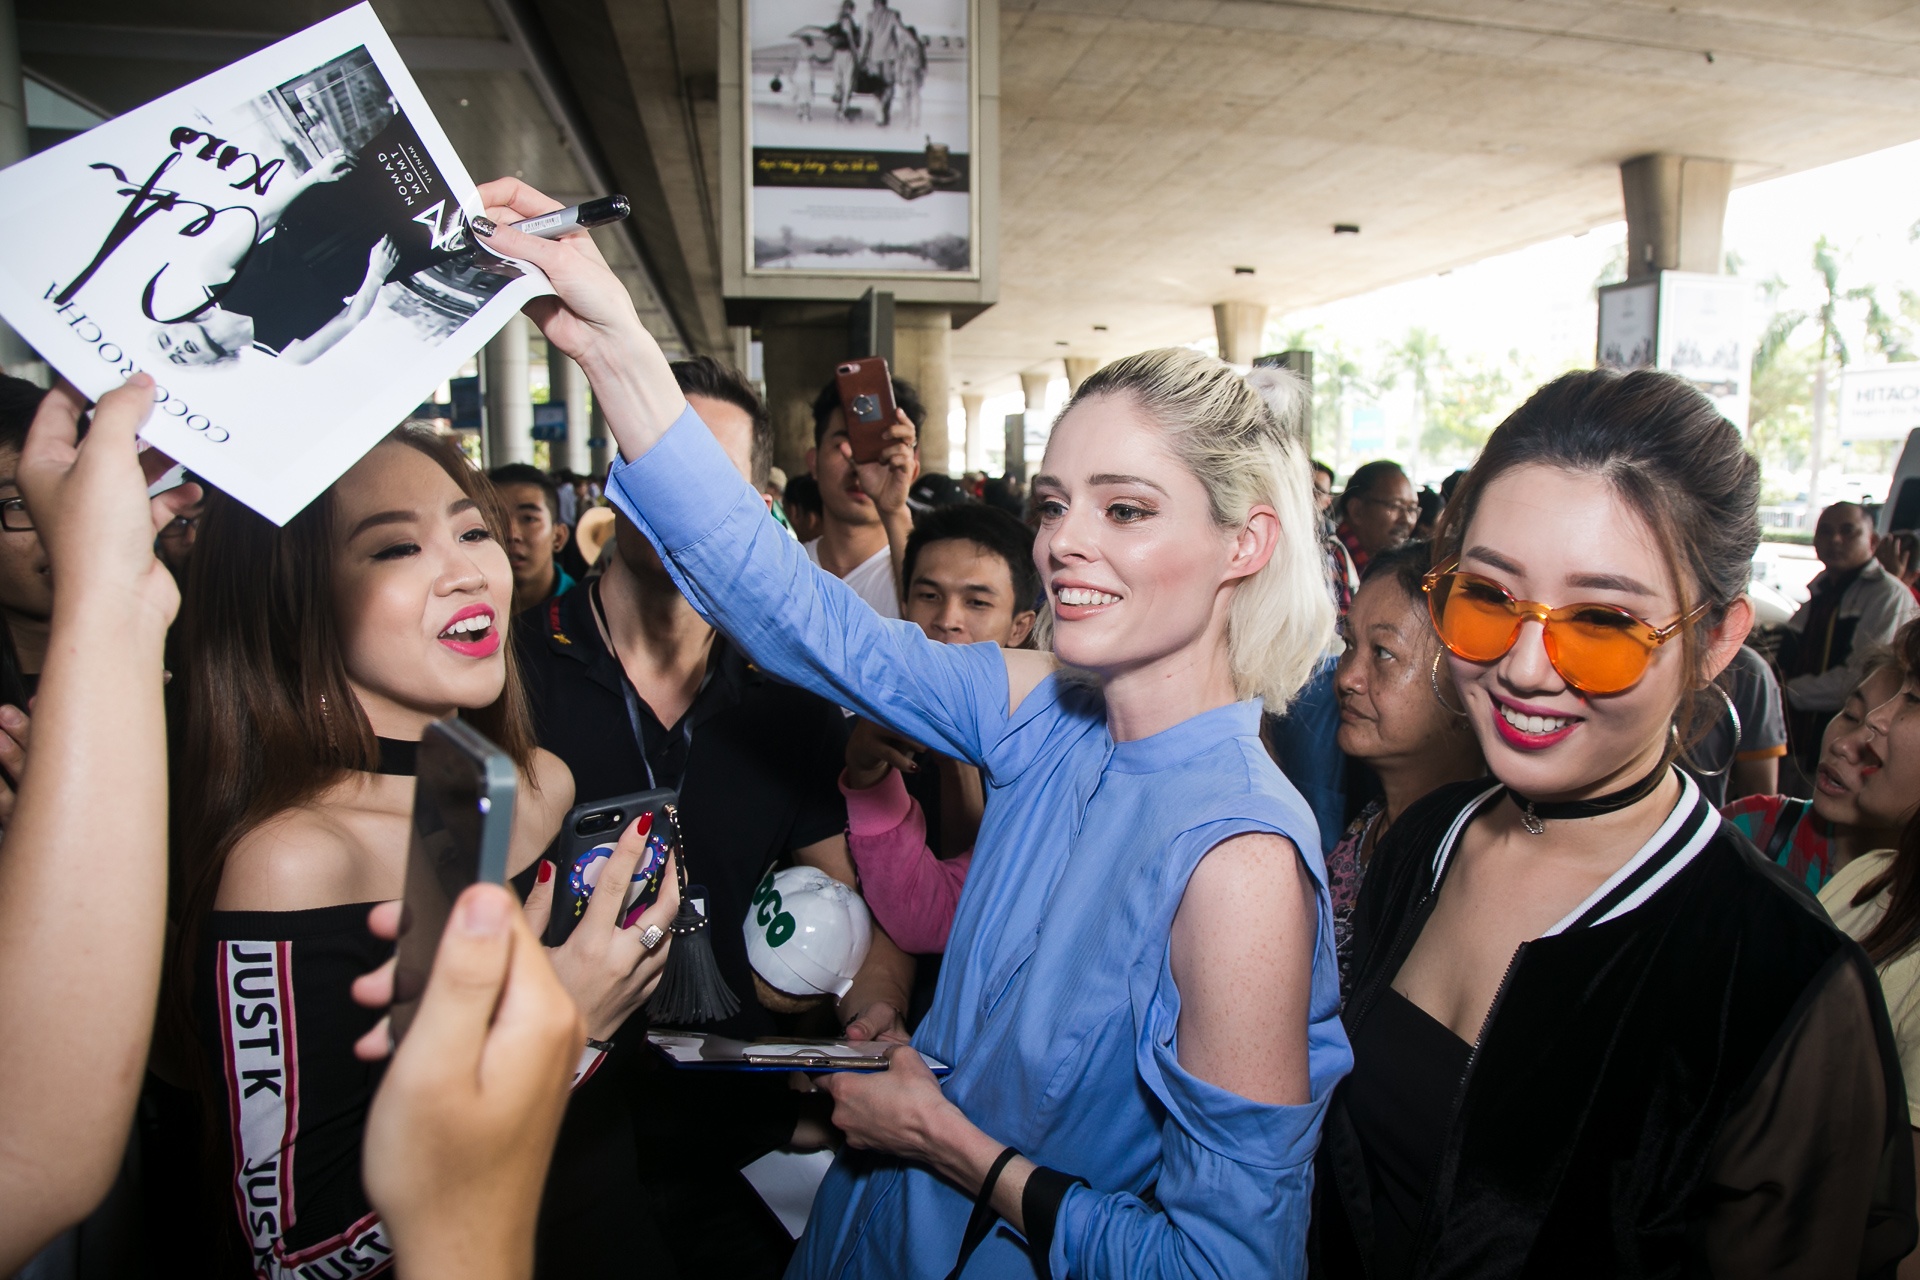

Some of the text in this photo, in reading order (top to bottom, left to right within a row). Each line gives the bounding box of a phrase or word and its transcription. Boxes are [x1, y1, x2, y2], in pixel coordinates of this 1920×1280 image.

[378, 153, 414, 206] NOMAD
[391, 151, 421, 194] MGMT
[408, 146, 432, 183] VIETNAM
[1857, 386, 1920, 402] HITAC
[231, 944, 282, 1099] JUST K
